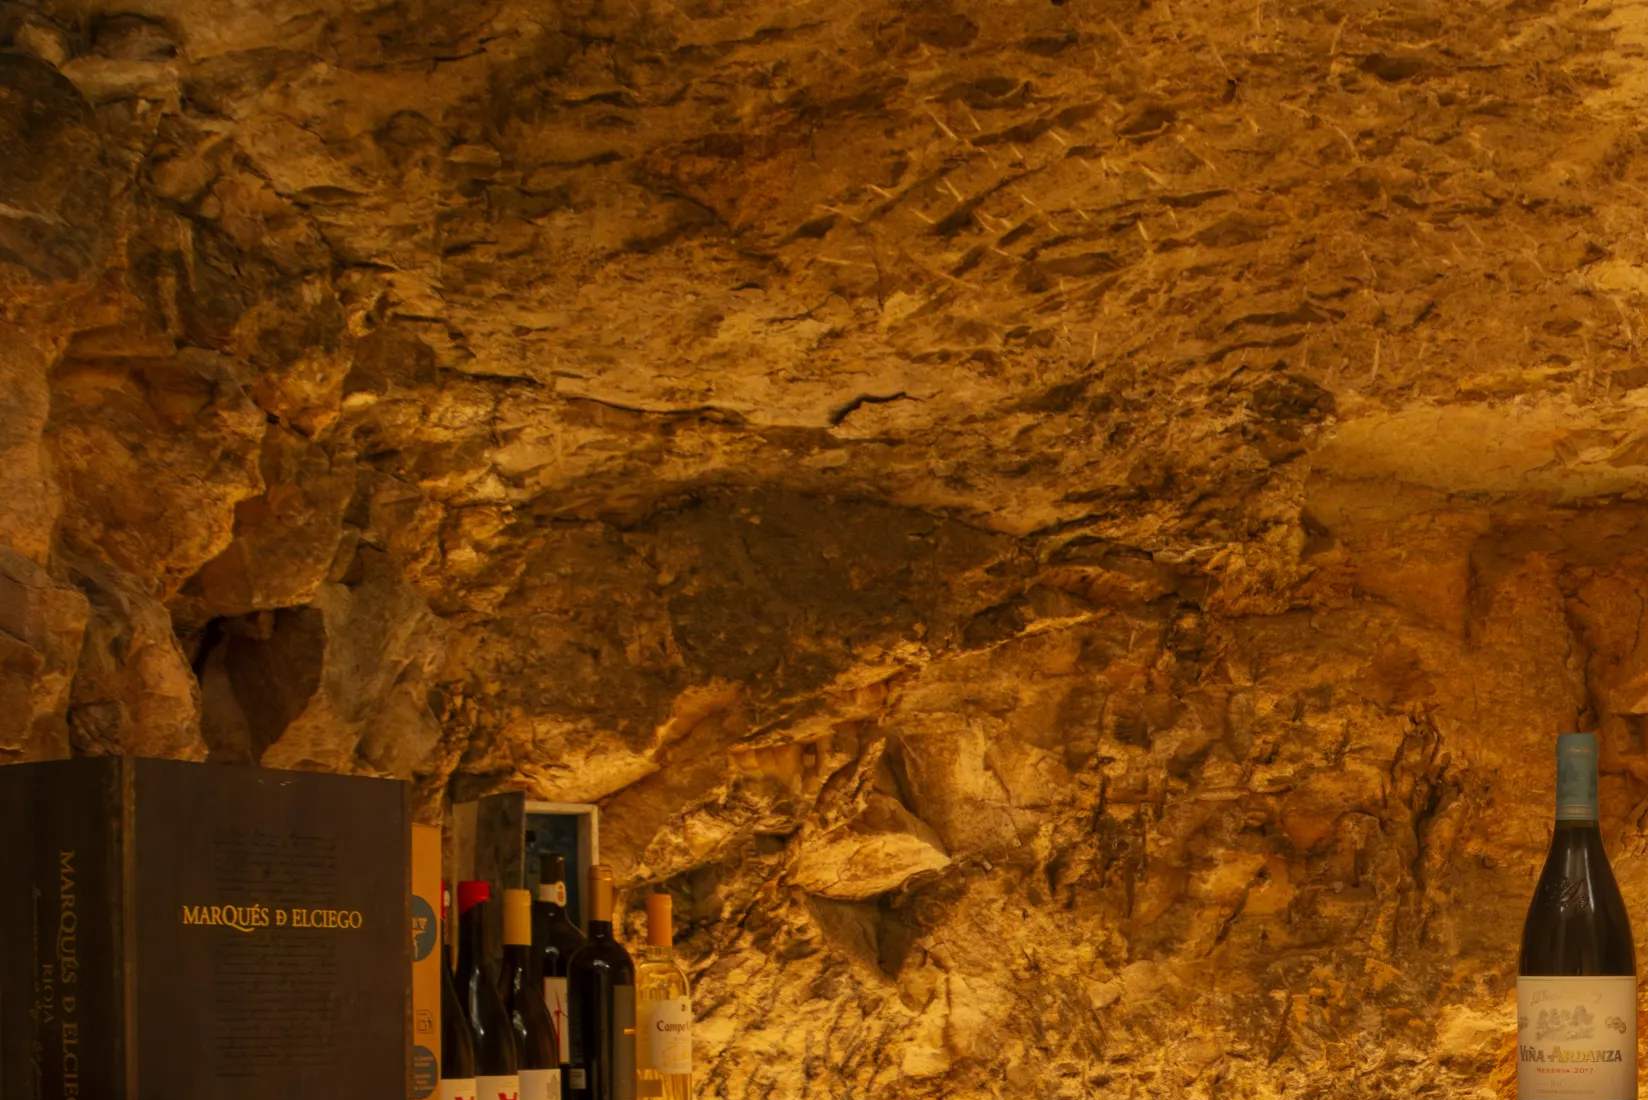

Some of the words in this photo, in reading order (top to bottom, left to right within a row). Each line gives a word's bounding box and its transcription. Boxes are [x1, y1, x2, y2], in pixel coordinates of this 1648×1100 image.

[182, 904, 270, 933] MARQUÉS
[292, 908, 363, 929] ELCIEGO
[1519, 1045, 1546, 1063] VIÑA
[1547, 1046, 1623, 1063] ARDANZA
